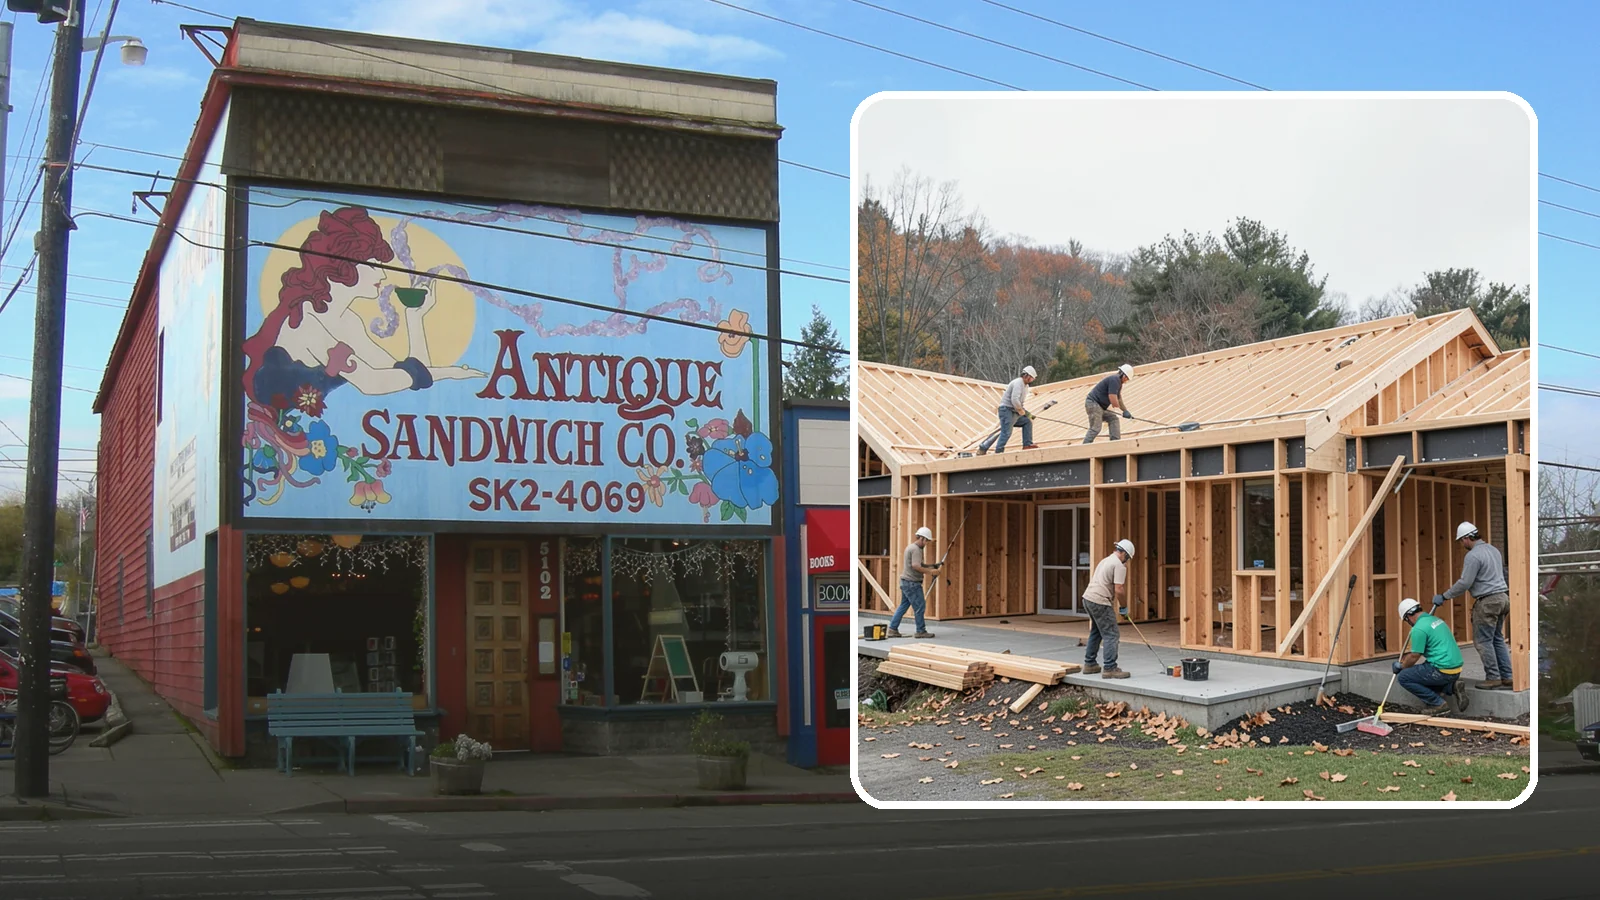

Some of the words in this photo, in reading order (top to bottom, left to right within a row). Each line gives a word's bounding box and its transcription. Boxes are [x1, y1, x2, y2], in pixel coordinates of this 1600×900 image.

[477, 329, 723, 420] ANTIQUE
[361, 408, 605, 466] SANDWICH
[617, 422, 685, 468] CO.
[468, 477, 646, 513] SK2-4069
[539, 541, 552, 600] 5102
[809, 555, 835, 569] BOOKS
